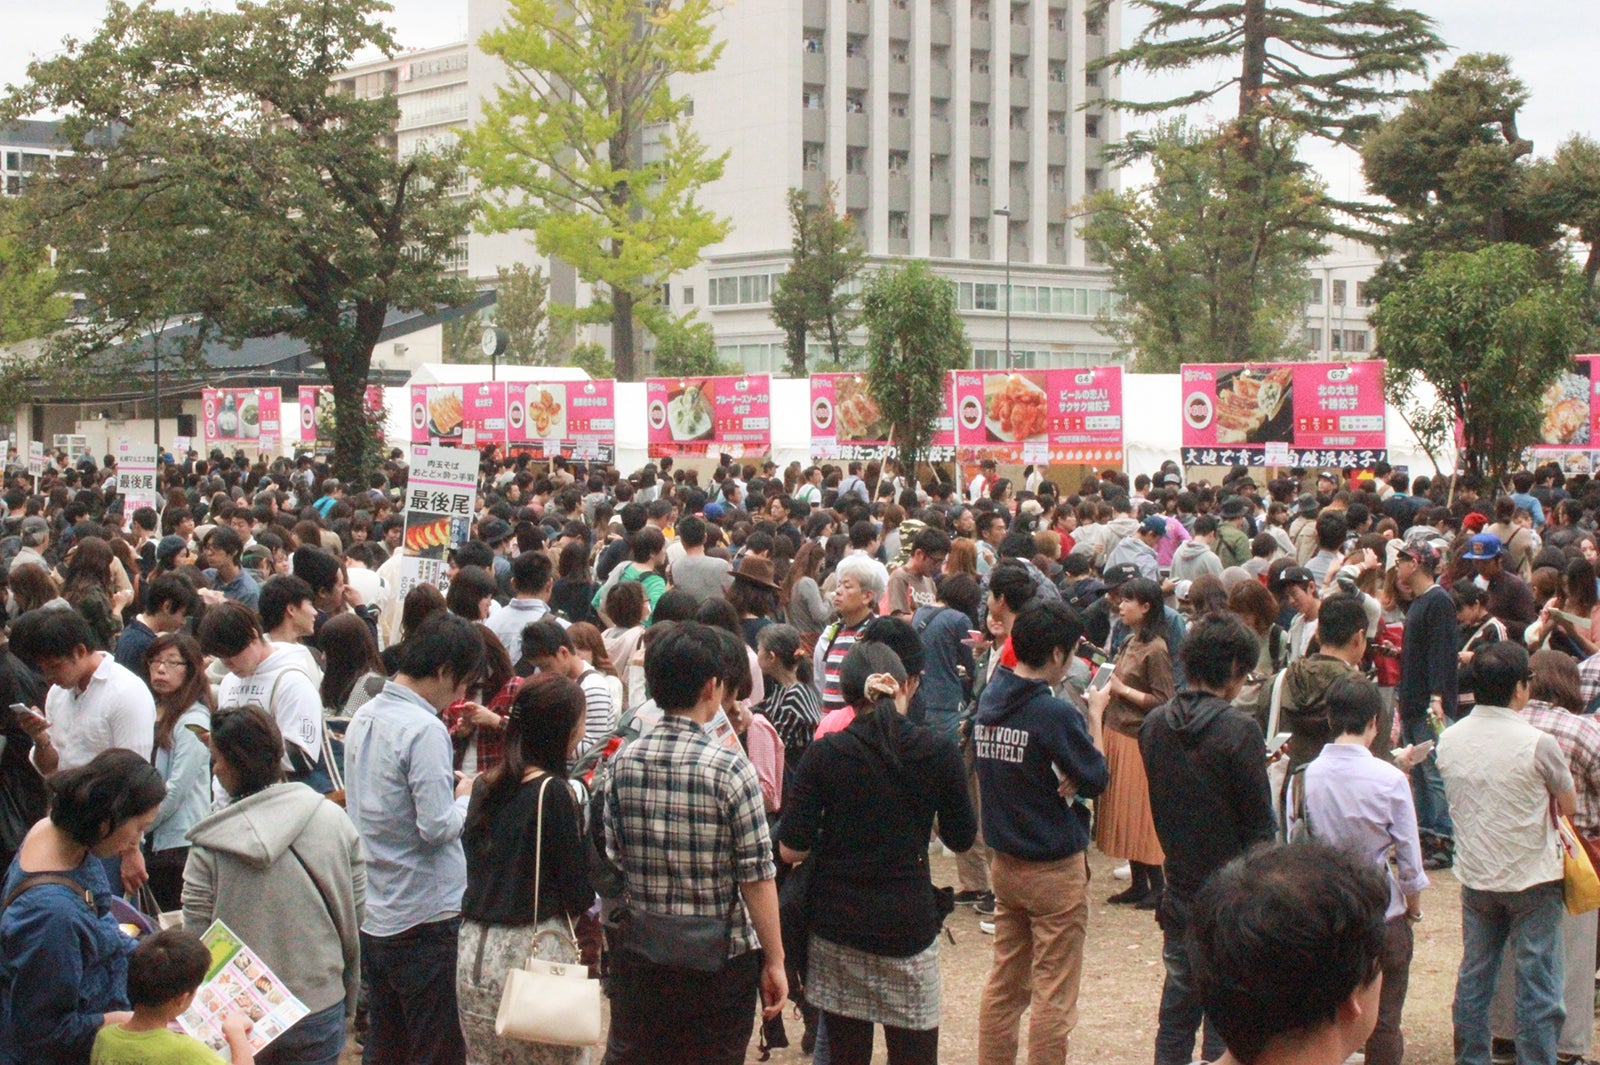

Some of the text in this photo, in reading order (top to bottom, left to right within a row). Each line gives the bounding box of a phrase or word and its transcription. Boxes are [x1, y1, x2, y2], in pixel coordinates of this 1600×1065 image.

[426, 459, 460, 471] 肉玉そば
[119, 474, 153, 490] 最後尾
[410, 490, 471, 515] 最後尾
